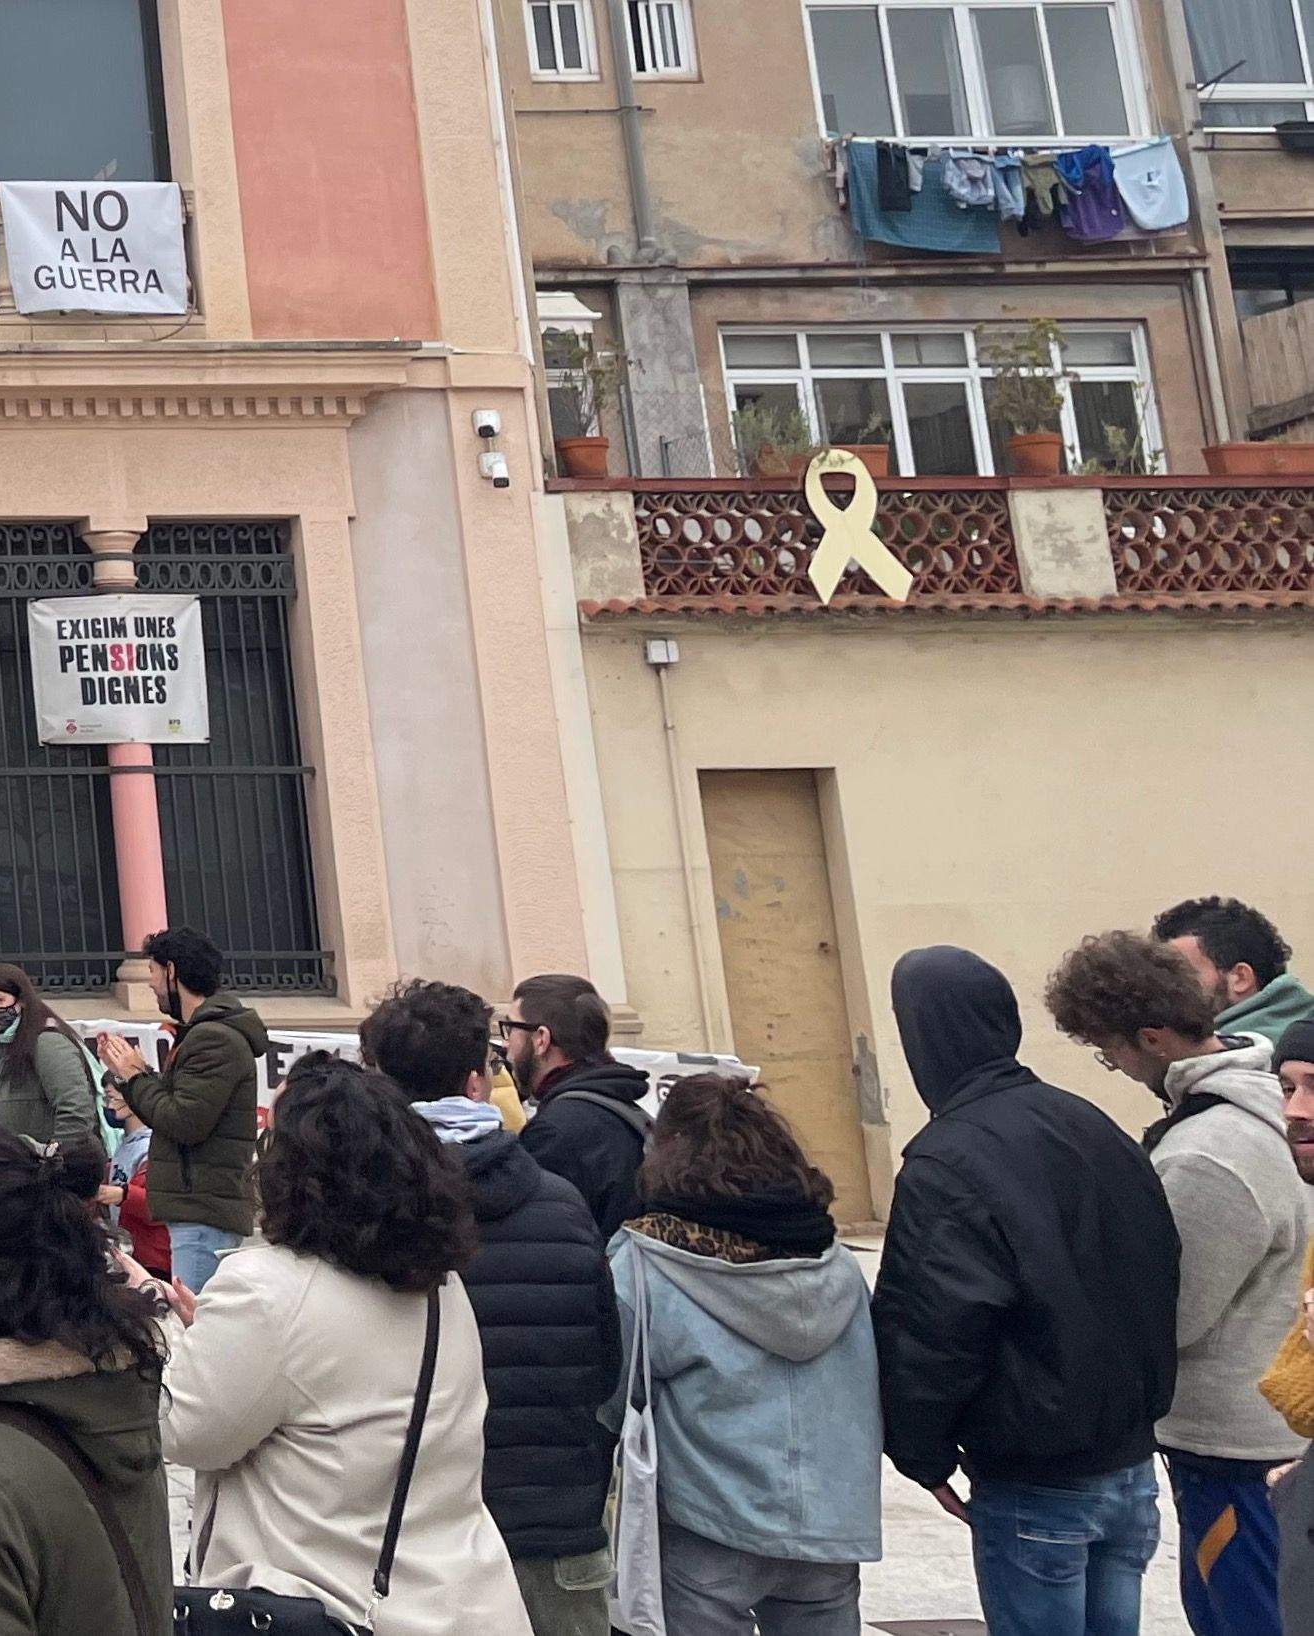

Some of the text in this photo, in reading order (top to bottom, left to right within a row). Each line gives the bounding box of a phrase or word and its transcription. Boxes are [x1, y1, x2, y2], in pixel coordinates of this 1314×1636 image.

[55, 190, 129, 231] NO
[61, 237, 130, 263] A LA
[34, 265, 164, 293] GUERRA
[56, 616, 176, 640] EXIGIM UNES
[59, 643, 179, 673] PENSIONS
[80, 676, 167, 705] DIGNES
